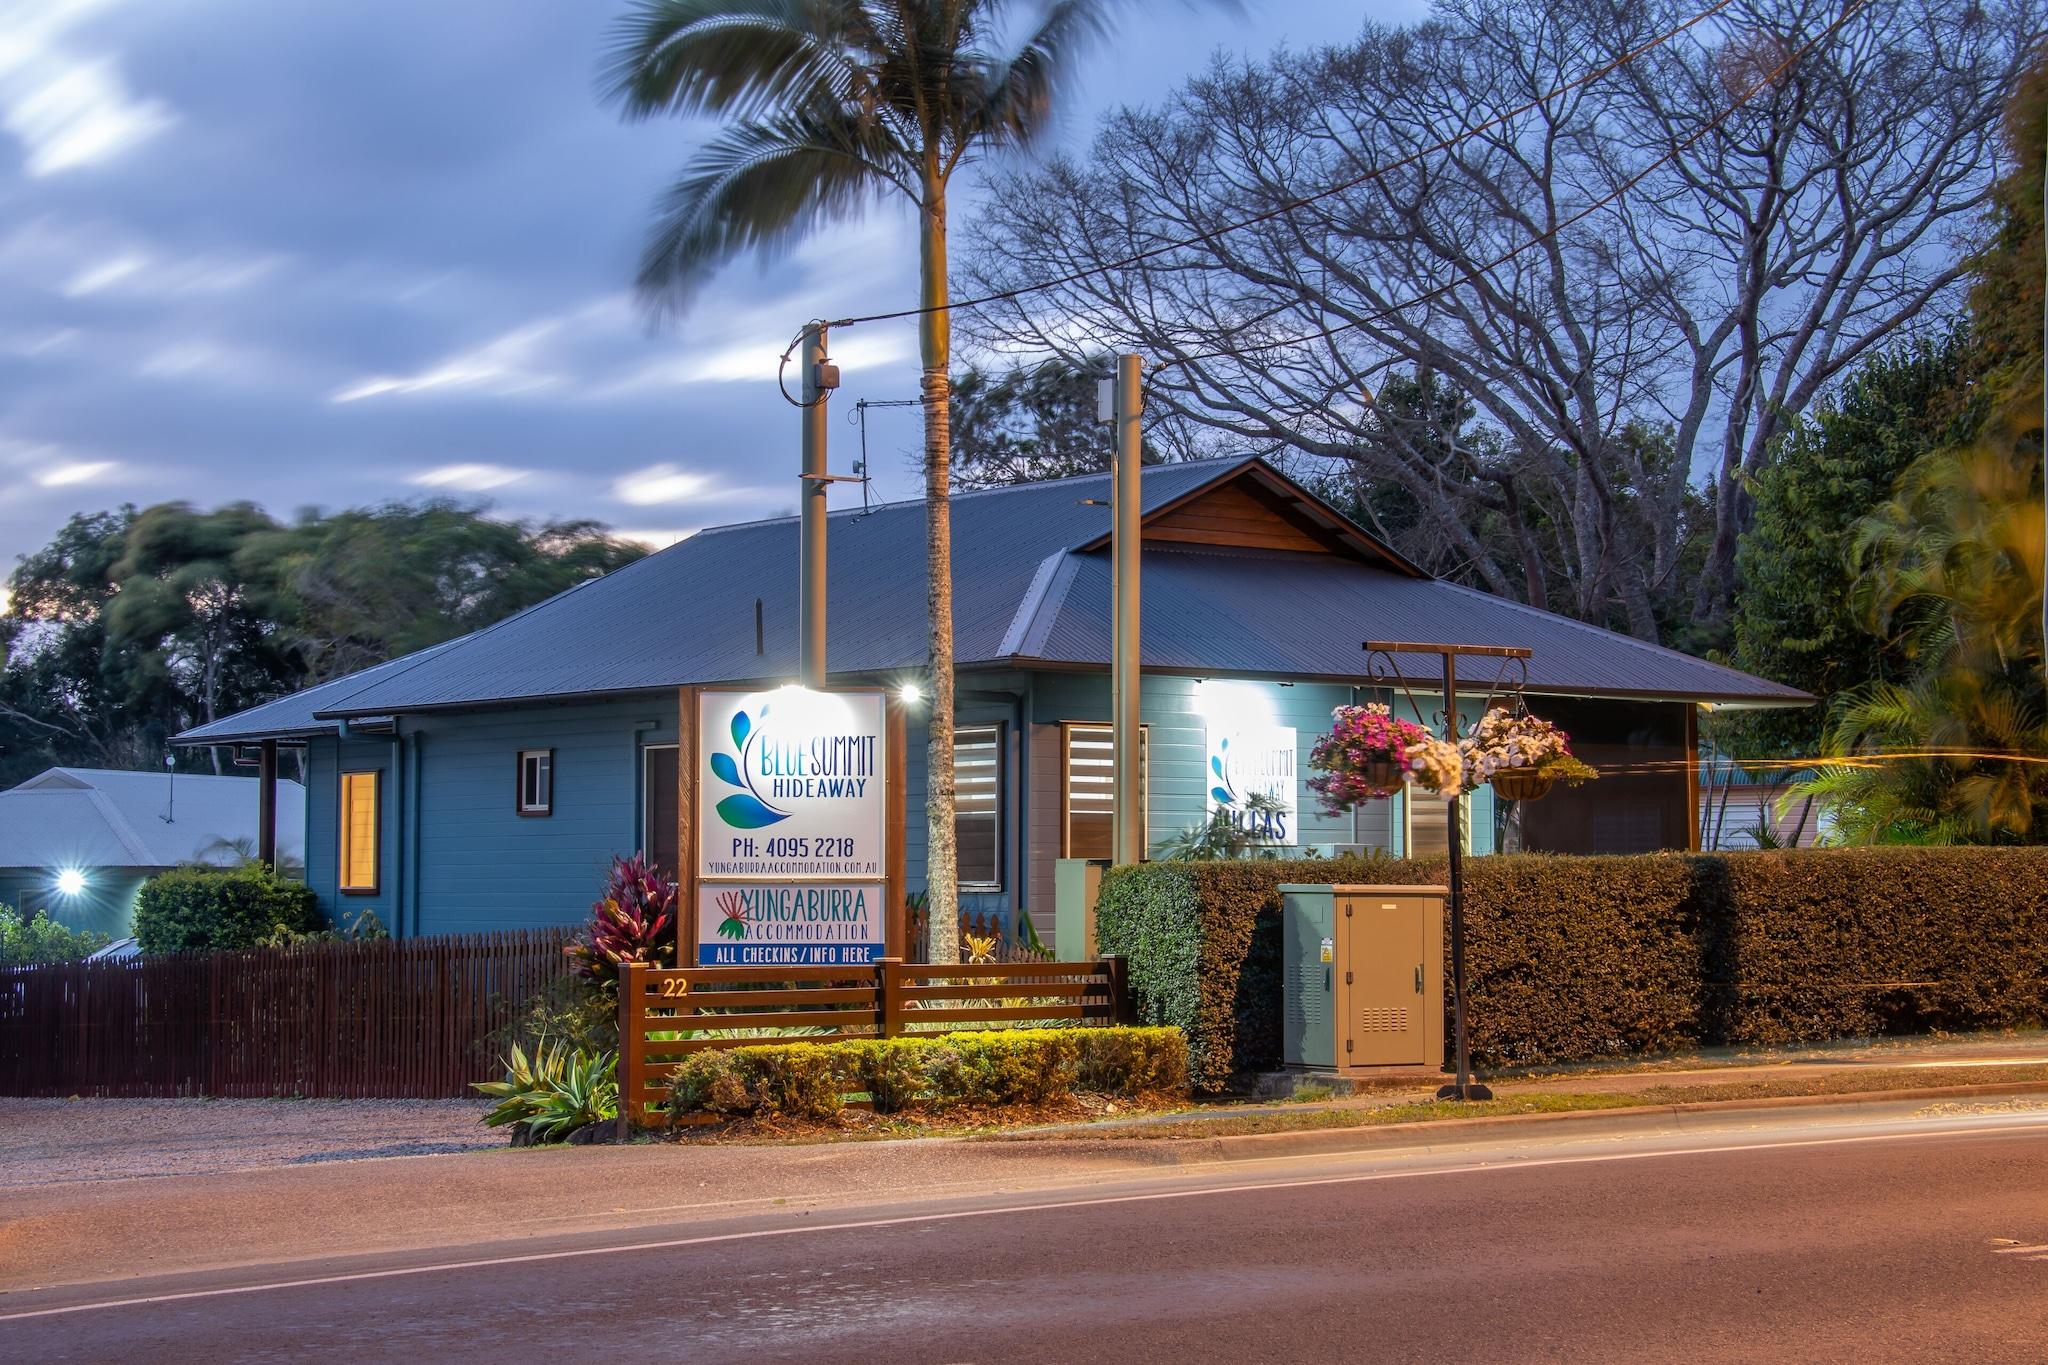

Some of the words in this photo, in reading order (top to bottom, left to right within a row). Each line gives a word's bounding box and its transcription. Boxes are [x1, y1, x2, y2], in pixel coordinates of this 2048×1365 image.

[773, 778, 867, 798] HIDEAWAY
[1217, 810, 1286, 840] ILLAS
[732, 838, 759, 858] PH:
[766, 838, 809, 858] 4095
[815, 838, 854, 858] 2218
[708, 861, 878, 874] YUNGABURRAACCOMMODATION.COM.AU
[740, 889, 868, 922] YUNGABURRA
[745, 924, 868, 940] ACCOMMODATION
[715, 947, 737, 963] ALL
[842, 947, 870, 963] HERE
[663, 977, 688, 997] 22
